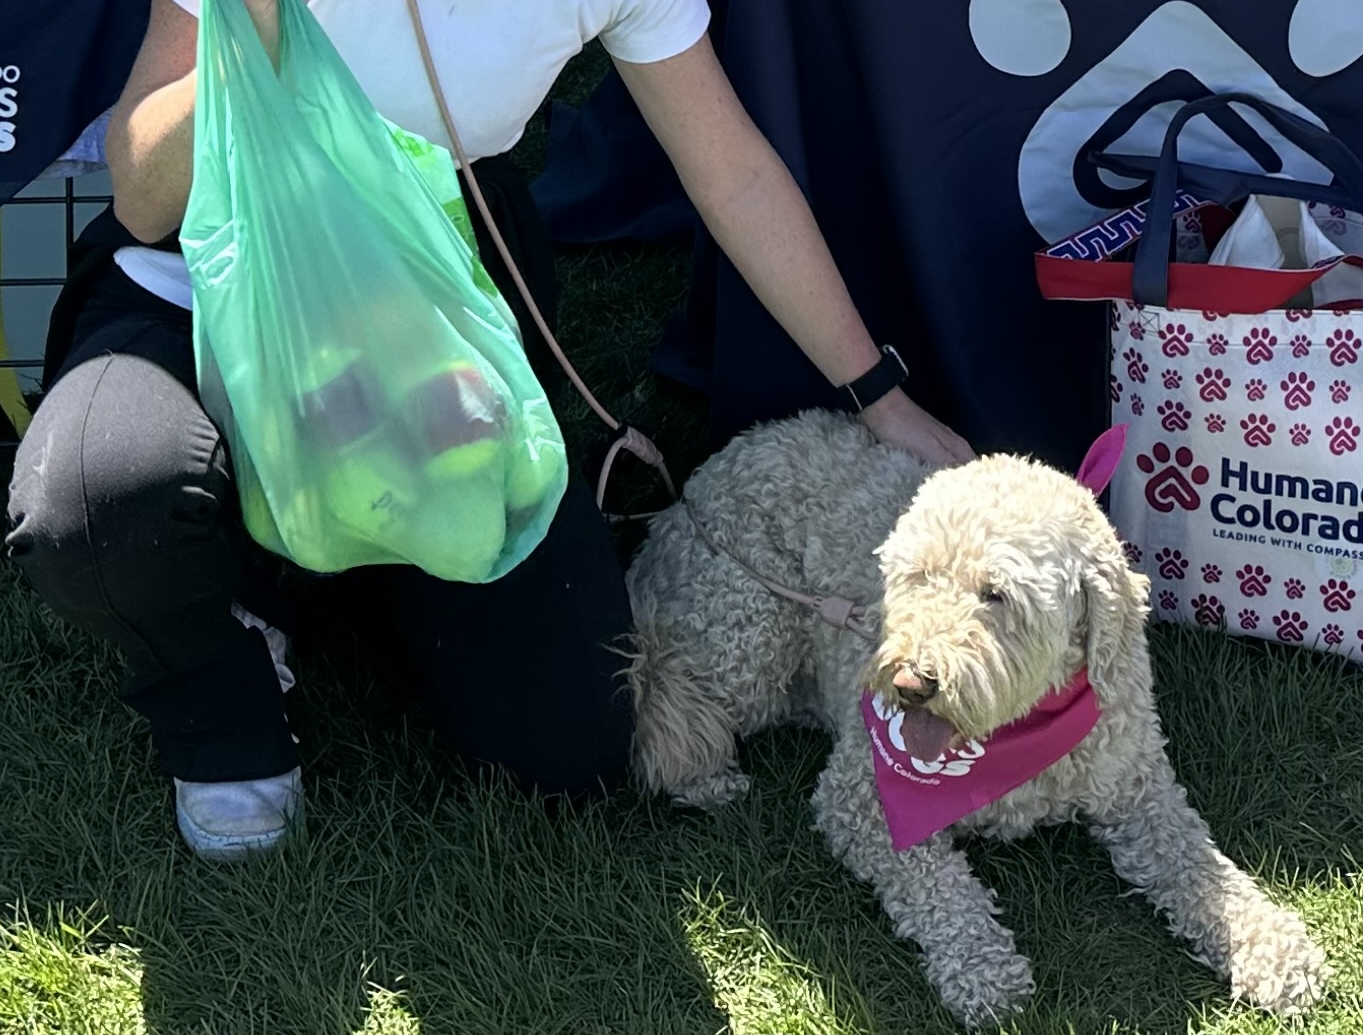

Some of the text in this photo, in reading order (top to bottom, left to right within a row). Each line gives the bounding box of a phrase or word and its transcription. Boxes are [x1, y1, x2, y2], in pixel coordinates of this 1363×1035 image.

[1212, 528, 1266, 544] LEADING
[1270, 536, 1302, 551] WITH
[894, 762, 941, 785] Colorado
